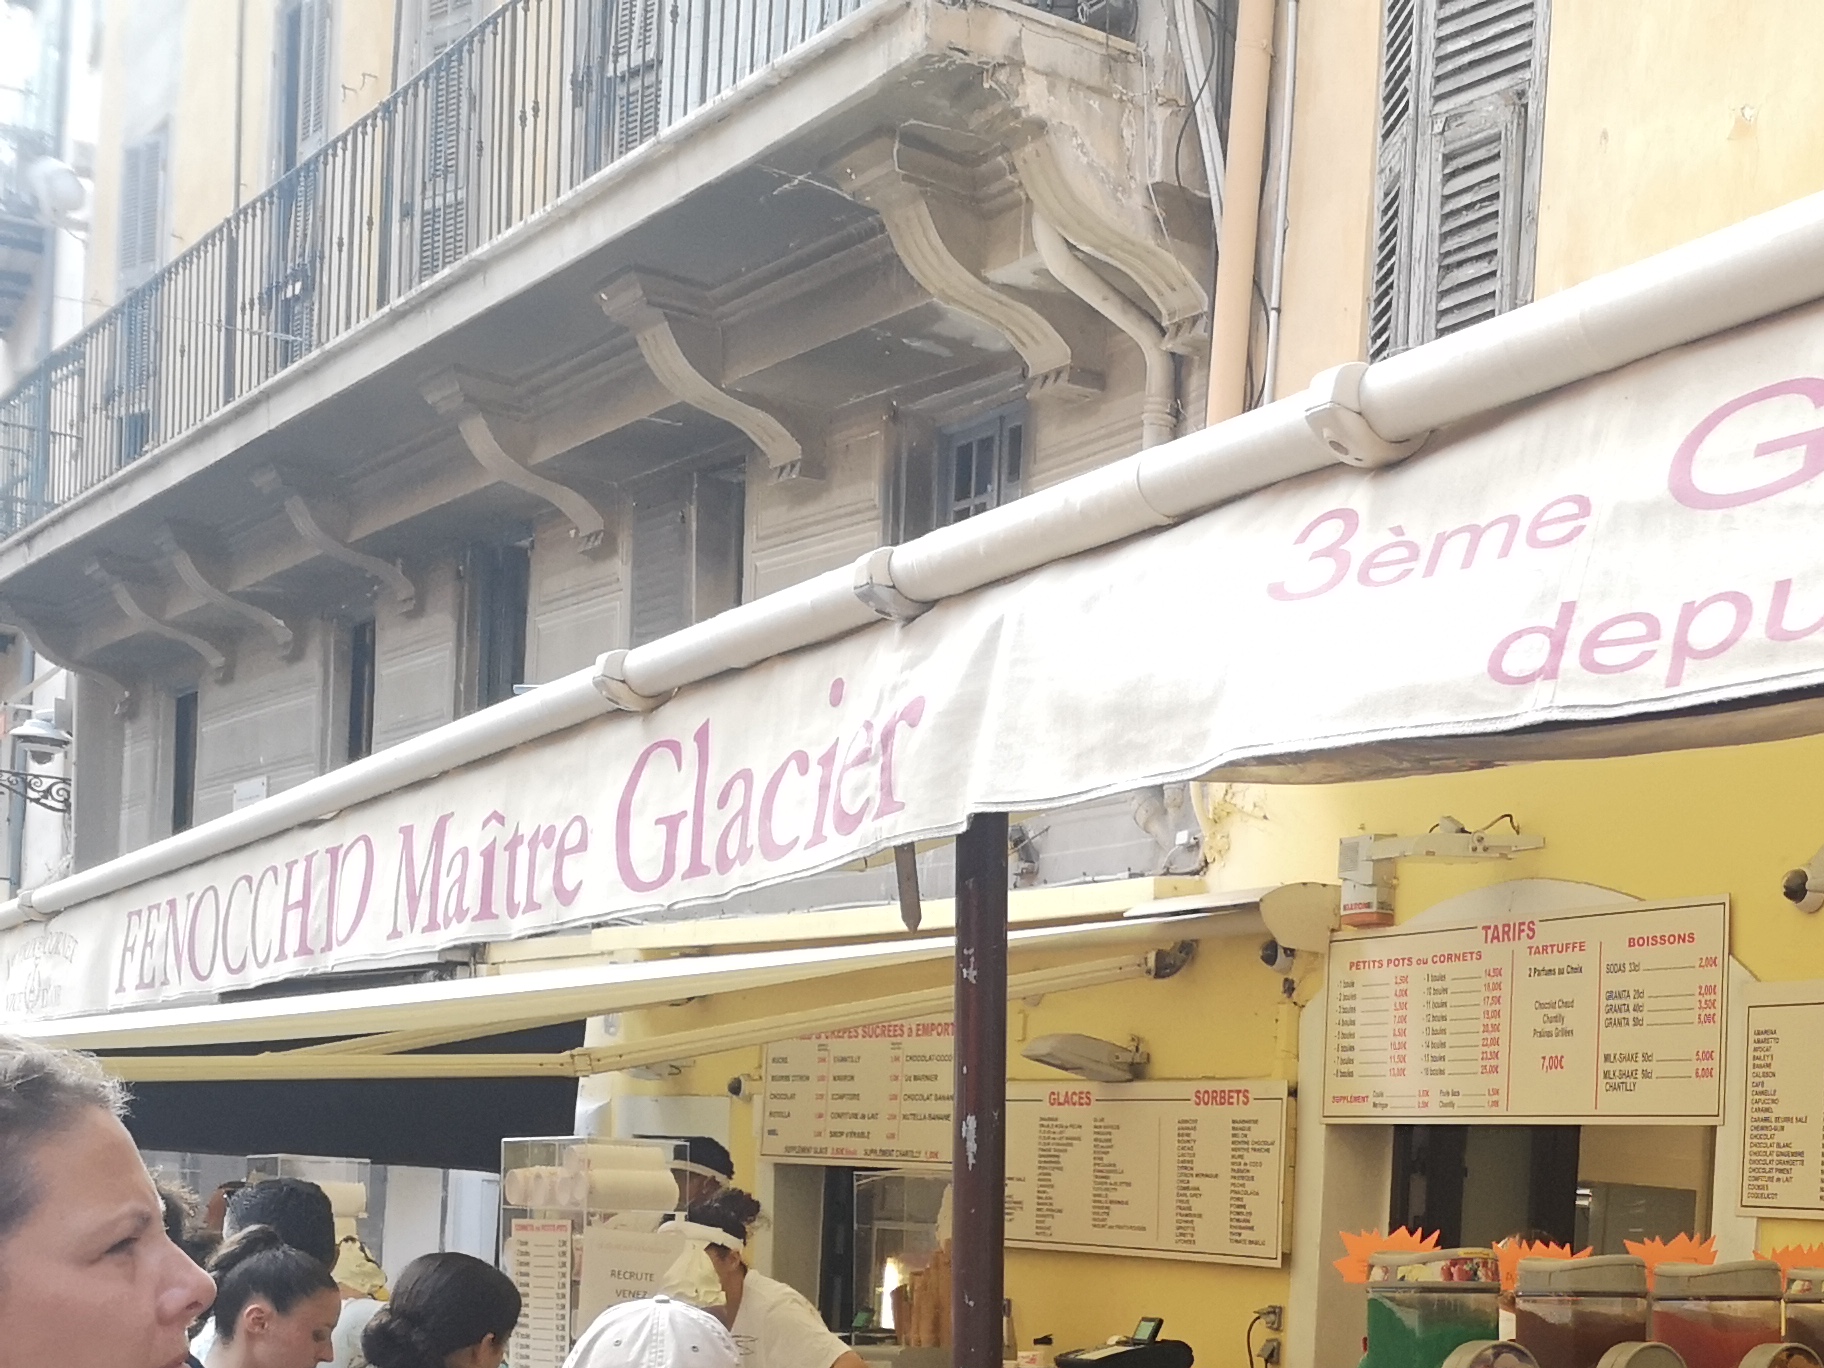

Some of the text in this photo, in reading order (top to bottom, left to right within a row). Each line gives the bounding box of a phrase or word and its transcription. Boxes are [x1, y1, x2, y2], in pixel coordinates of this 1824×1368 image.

[1266, 493, 1592, 602] 3ème
[386, 809, 588, 939] Maître
[615, 677, 926, 893] Glacier
[1482, 920, 1536, 944] TARIFS
[1628, 932, 1695, 948] BOISSONS
[1527, 941, 1586, 956] TARTUFFE
[1349, 951, 1482, 971] PETITS POTS ou CORNETS
[1605, 956, 1718, 974] SODAS 33cl 2,00€
[1533, 965, 1556, 977] Parfums
[1566, 964, 1583, 975] Choix
[1605, 985, 1717, 1001] GRANITA 20cl 2,00€
[1534, 998, 1574, 1010] Chocolat Chaud
[1605, 999, 1716, 1014] GRANITA 40cl 3,50€
[1542, 1014, 1565, 1025] Chantilly
[1604, 1017, 1630, 1028] GRANITA
[1697, 1013, 1716, 1025] 5,00€
[915, 1022, 955, 1037] EMPORT
[1541, 1055, 1564, 1073] 7,00€
[1603, 1050, 1714, 1063] MILK-SHAKE 50cl 5,00€
[1603, 1069, 1638, 1080] MILK-SHAKE
[1695, 1068, 1714, 1079] 6,00€
[1605, 1081, 1636, 1092] CHANTILLY
[1048, 1089, 1250, 1106] GLACES SORBETS
[610, 1269, 655, 1282] RECRUTE
[615, 1289, 648, 1299] VENEZ
